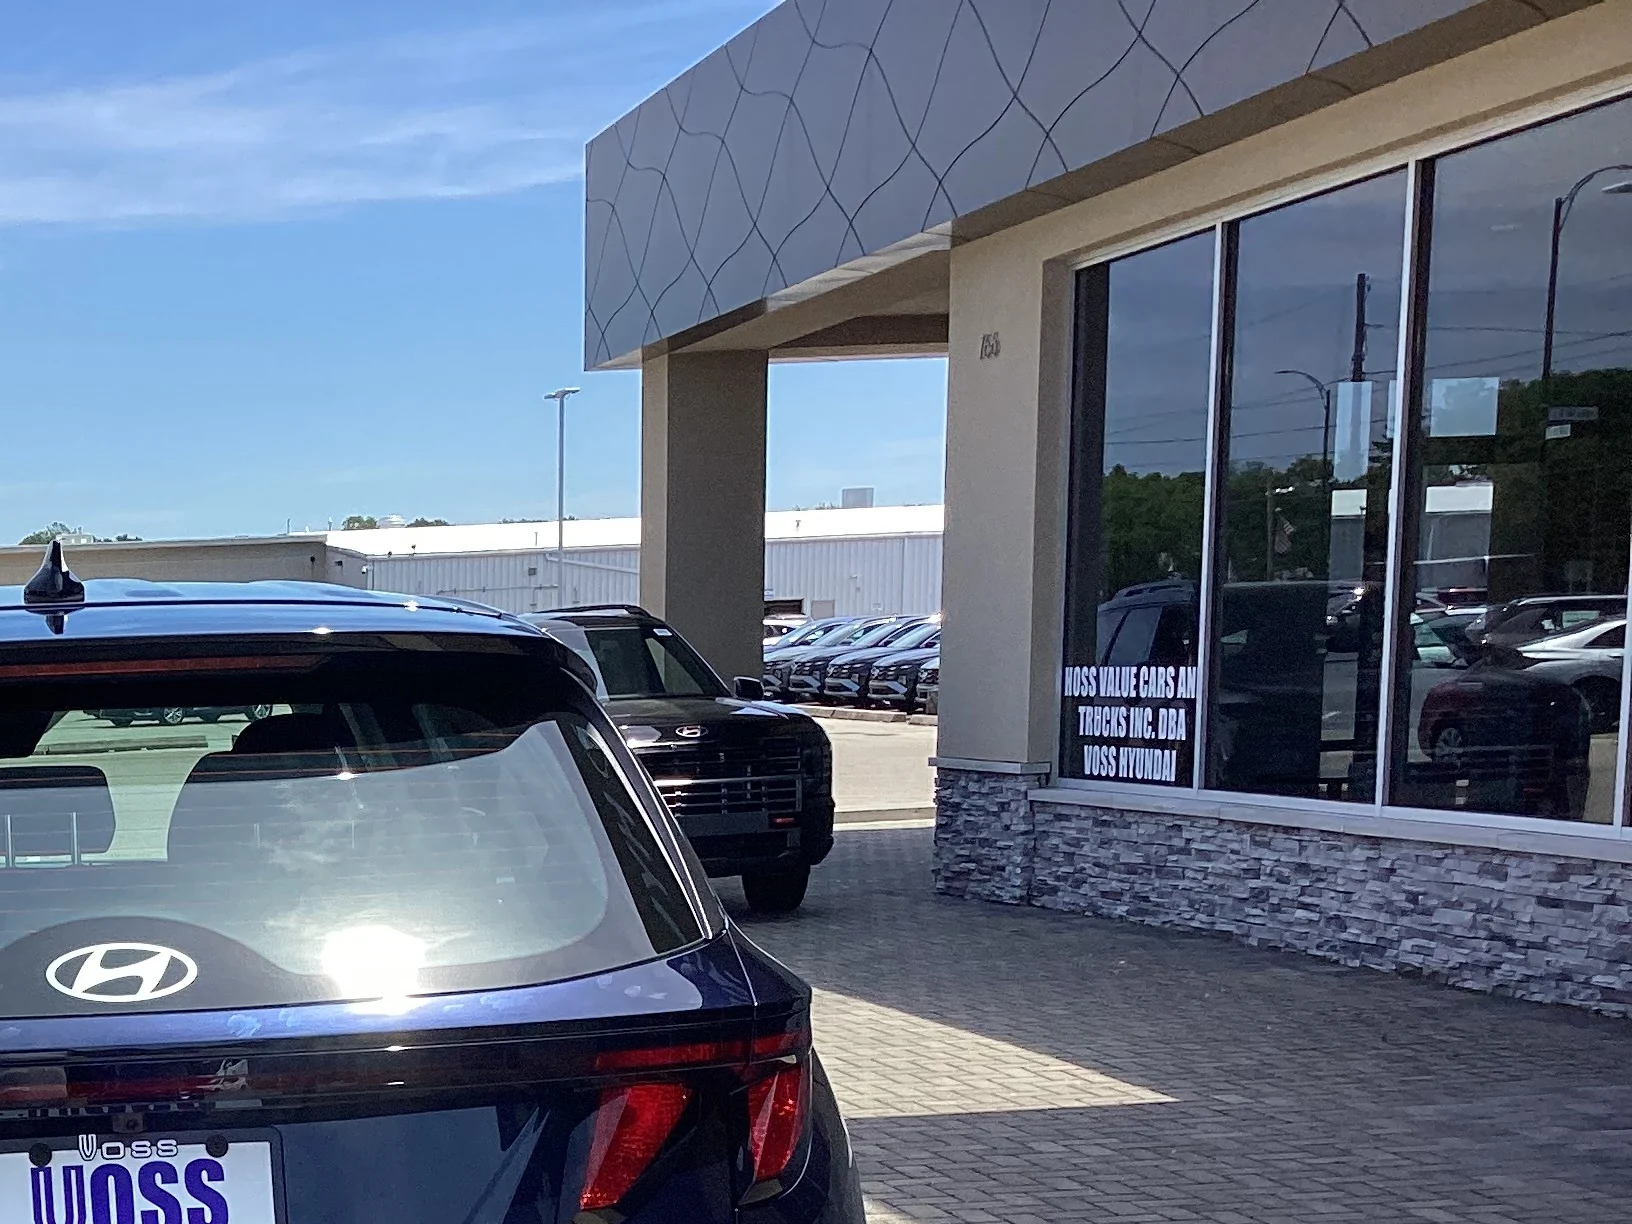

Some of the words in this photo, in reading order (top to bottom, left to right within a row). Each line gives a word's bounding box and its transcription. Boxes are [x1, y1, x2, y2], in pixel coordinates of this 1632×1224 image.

[1064, 666, 1097, 697] HOSS
[1099, 666, 1137, 698] VALUE
[1139, 666, 1175, 698] CARS
[1078, 706, 1127, 738] TRUCKS
[1129, 707, 1155, 739] INC.
[1157, 708, 1186, 741] DBA
[1083, 745, 1116, 777] VOSS
[1118, 747, 1176, 781] HYUNDAI
